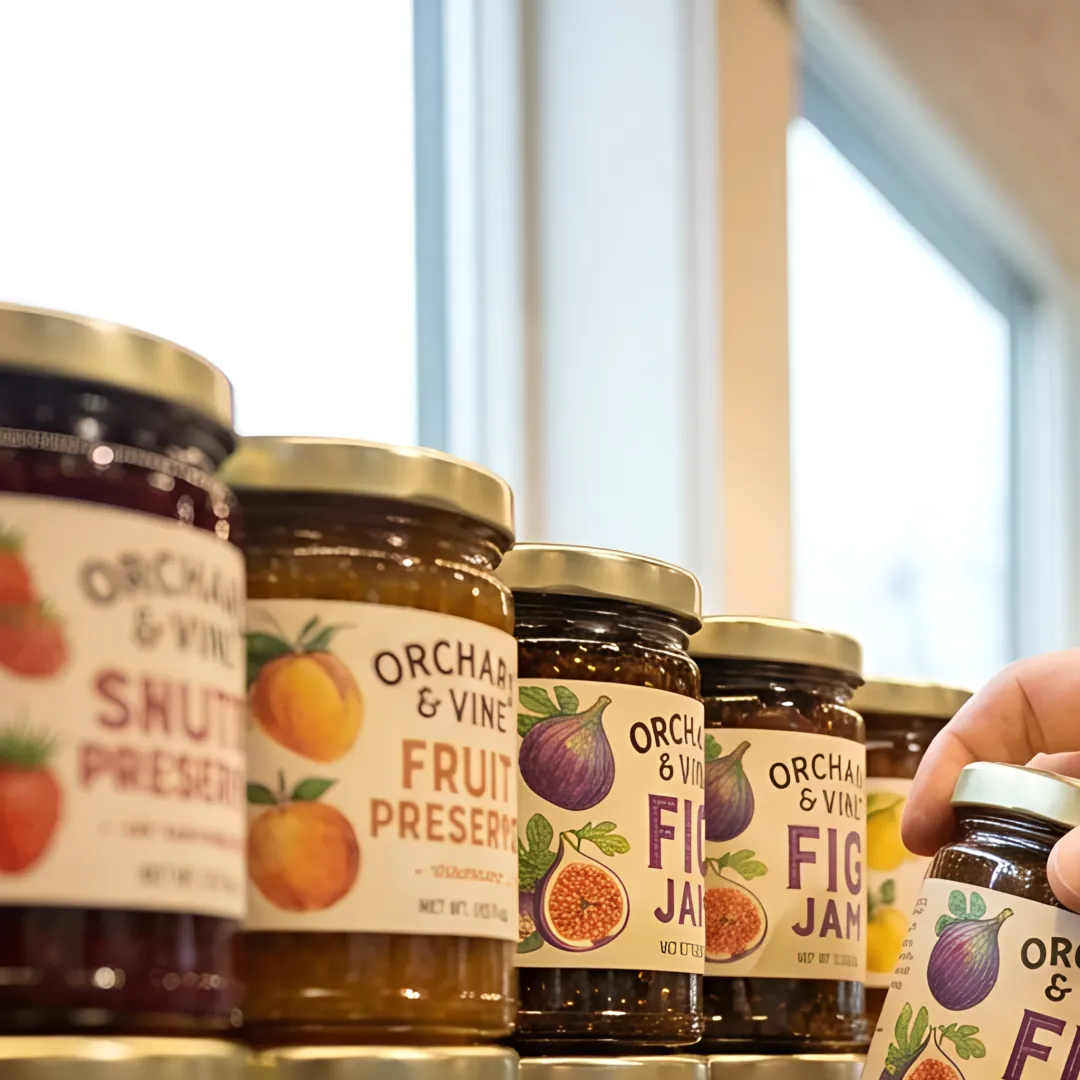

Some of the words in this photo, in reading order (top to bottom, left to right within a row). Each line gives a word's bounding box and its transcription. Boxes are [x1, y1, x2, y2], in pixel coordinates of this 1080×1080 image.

[418, 686, 441, 719] &
[449, 688, 507, 733] VINE
[402, 739, 511, 803] FRUIT
[659, 752, 674, 781] &
[800, 788, 817, 811] &
[787, 825, 861, 896] FIG
[792, 897, 861, 942] JAM
[1044, 973, 1072, 1002] &
